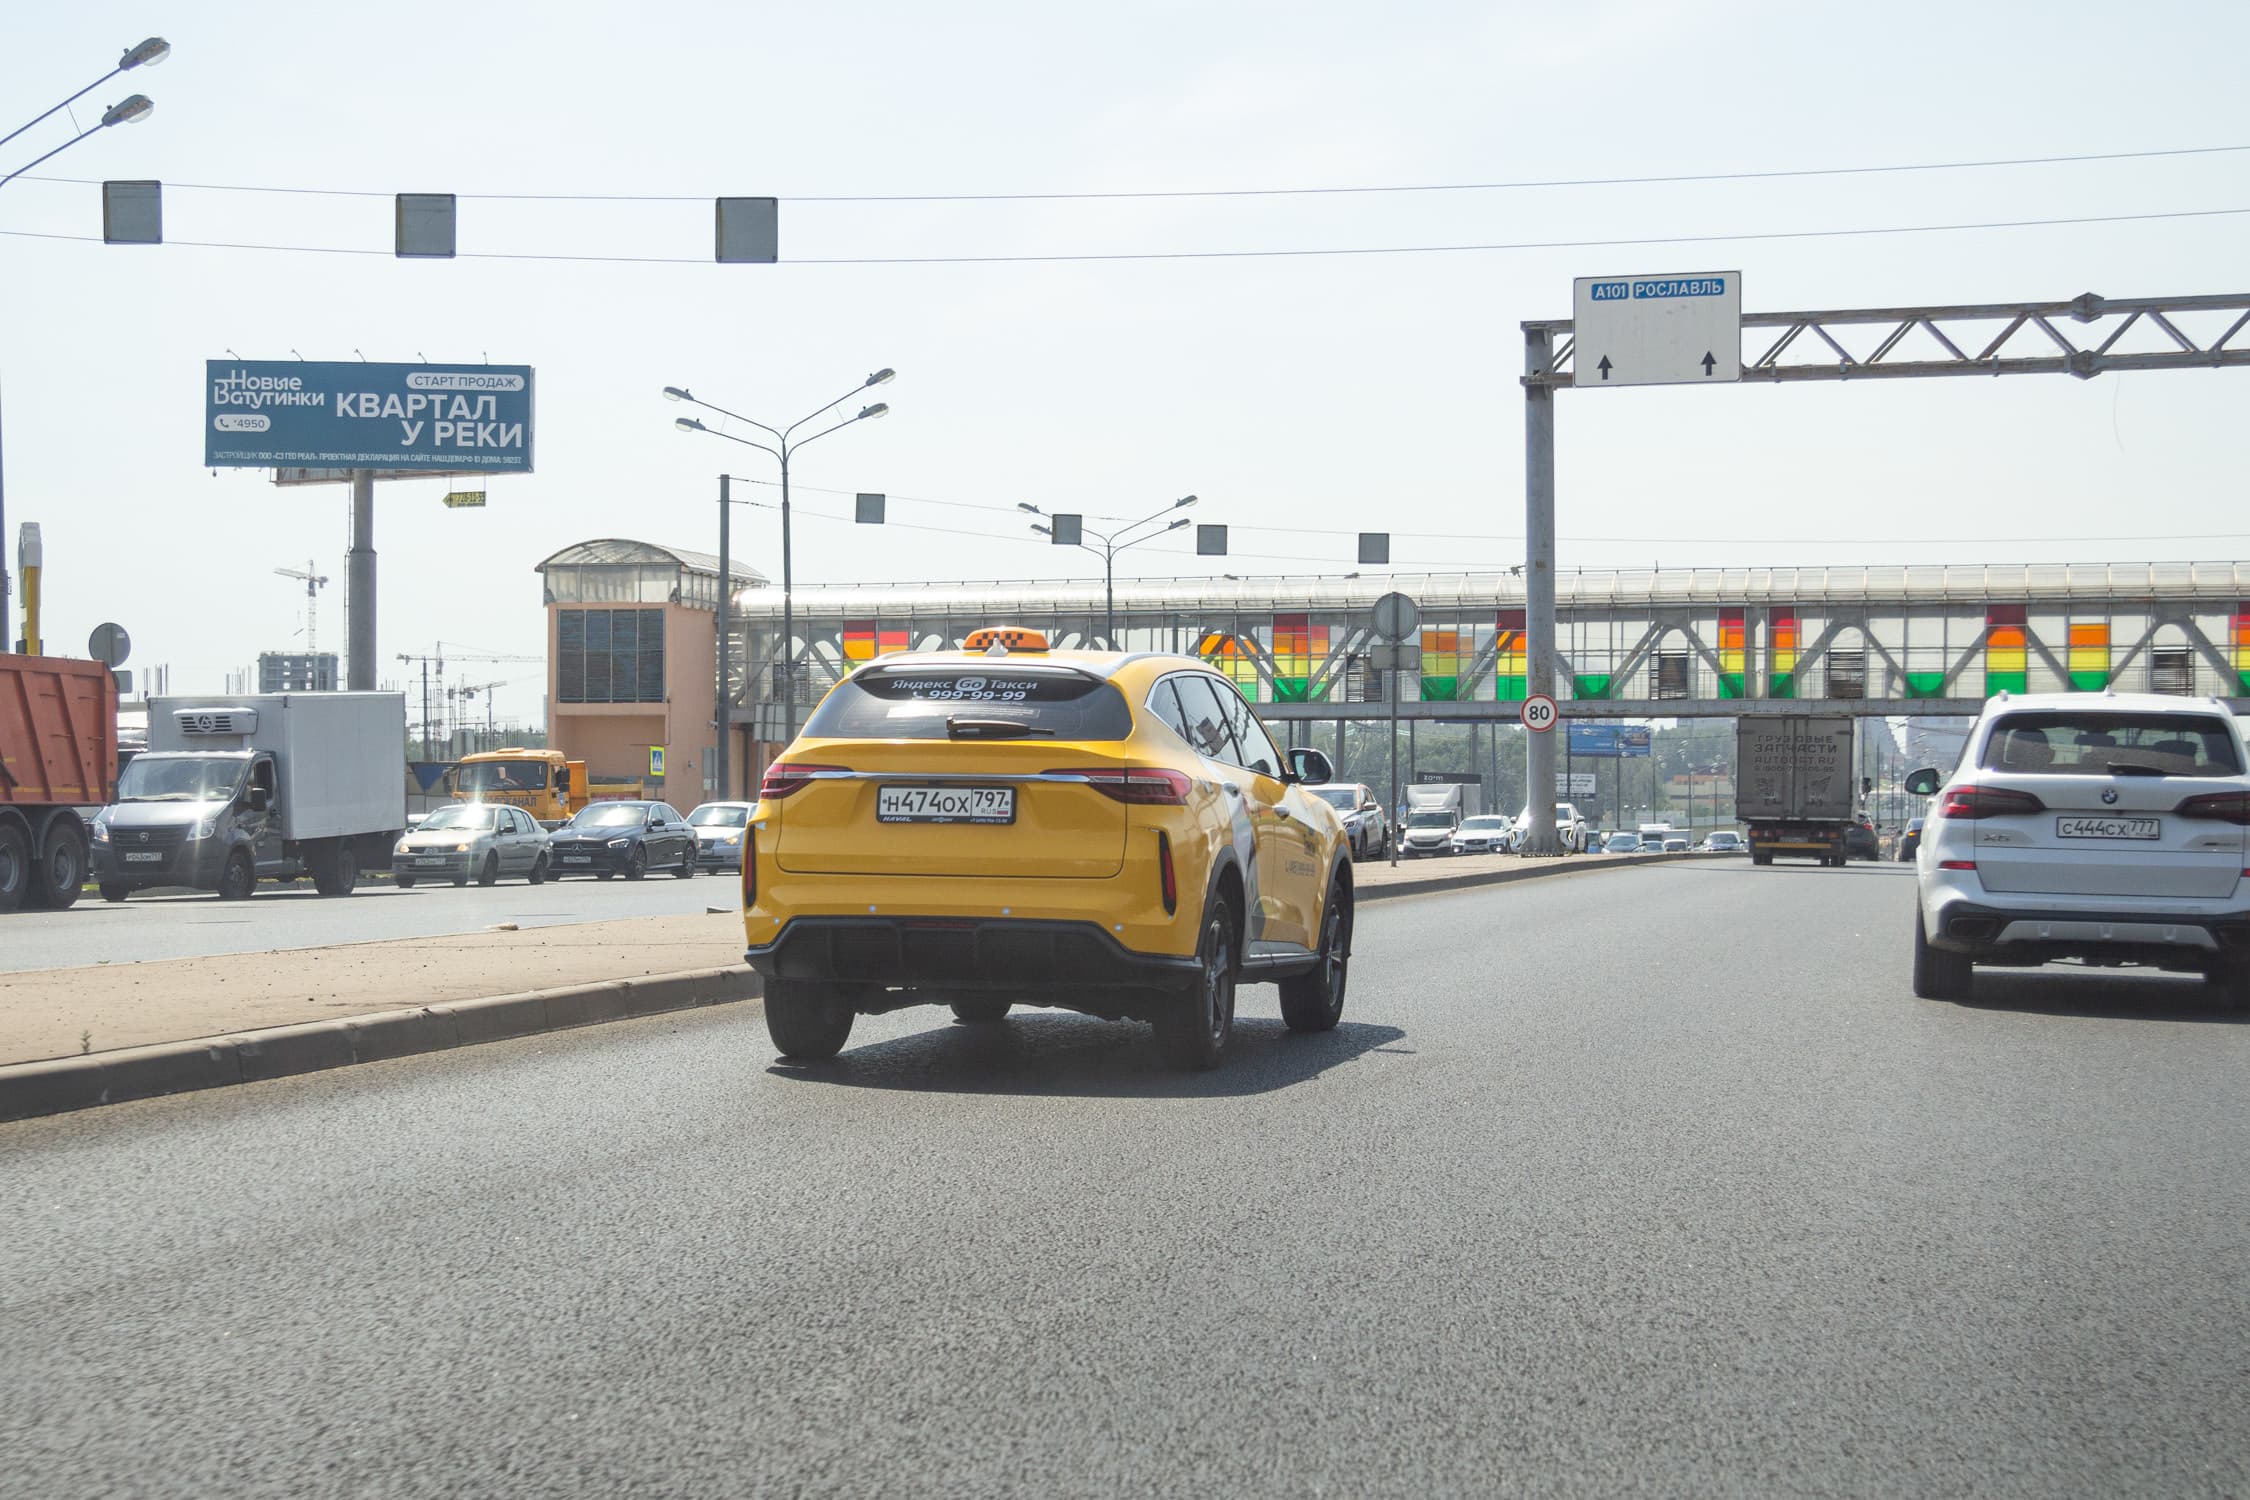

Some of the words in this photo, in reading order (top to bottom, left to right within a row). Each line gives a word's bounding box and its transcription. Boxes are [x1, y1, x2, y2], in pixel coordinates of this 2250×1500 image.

[1635, 281, 1722, 297] РОСЛАВЛЬ
[215, 369, 302, 390] Новые
[414, 375, 455, 387] СТАРТ
[458, 376, 516, 389] ПРОДАЖ
[214, 382, 325, 409] Ватутинки
[336, 393, 497, 420] КВАРТАЛ
[401, 420, 425, 446] У
[434, 421, 523, 448] РЕКИ
[319, 453, 357, 461] ПРОЕКТНАЯ
[357, 453, 400, 463] ДЕКЛАРАЦИЯ
[401, 454, 410, 462] НА
[411, 452, 431, 462] САЙТЕ
[891, 680, 952, 690] Яндекс
[957, 678, 985, 690] Go
[991, 679, 1038, 689] Такси
[927, 690, 1026, 700] 999-99-99
[1529, 706, 1550, 720] 80
[1754, 744, 1837, 753] ЗАПЧАСТИ
[974, 791, 1007, 808] 797
[2129, 820, 2154, 833] 777
